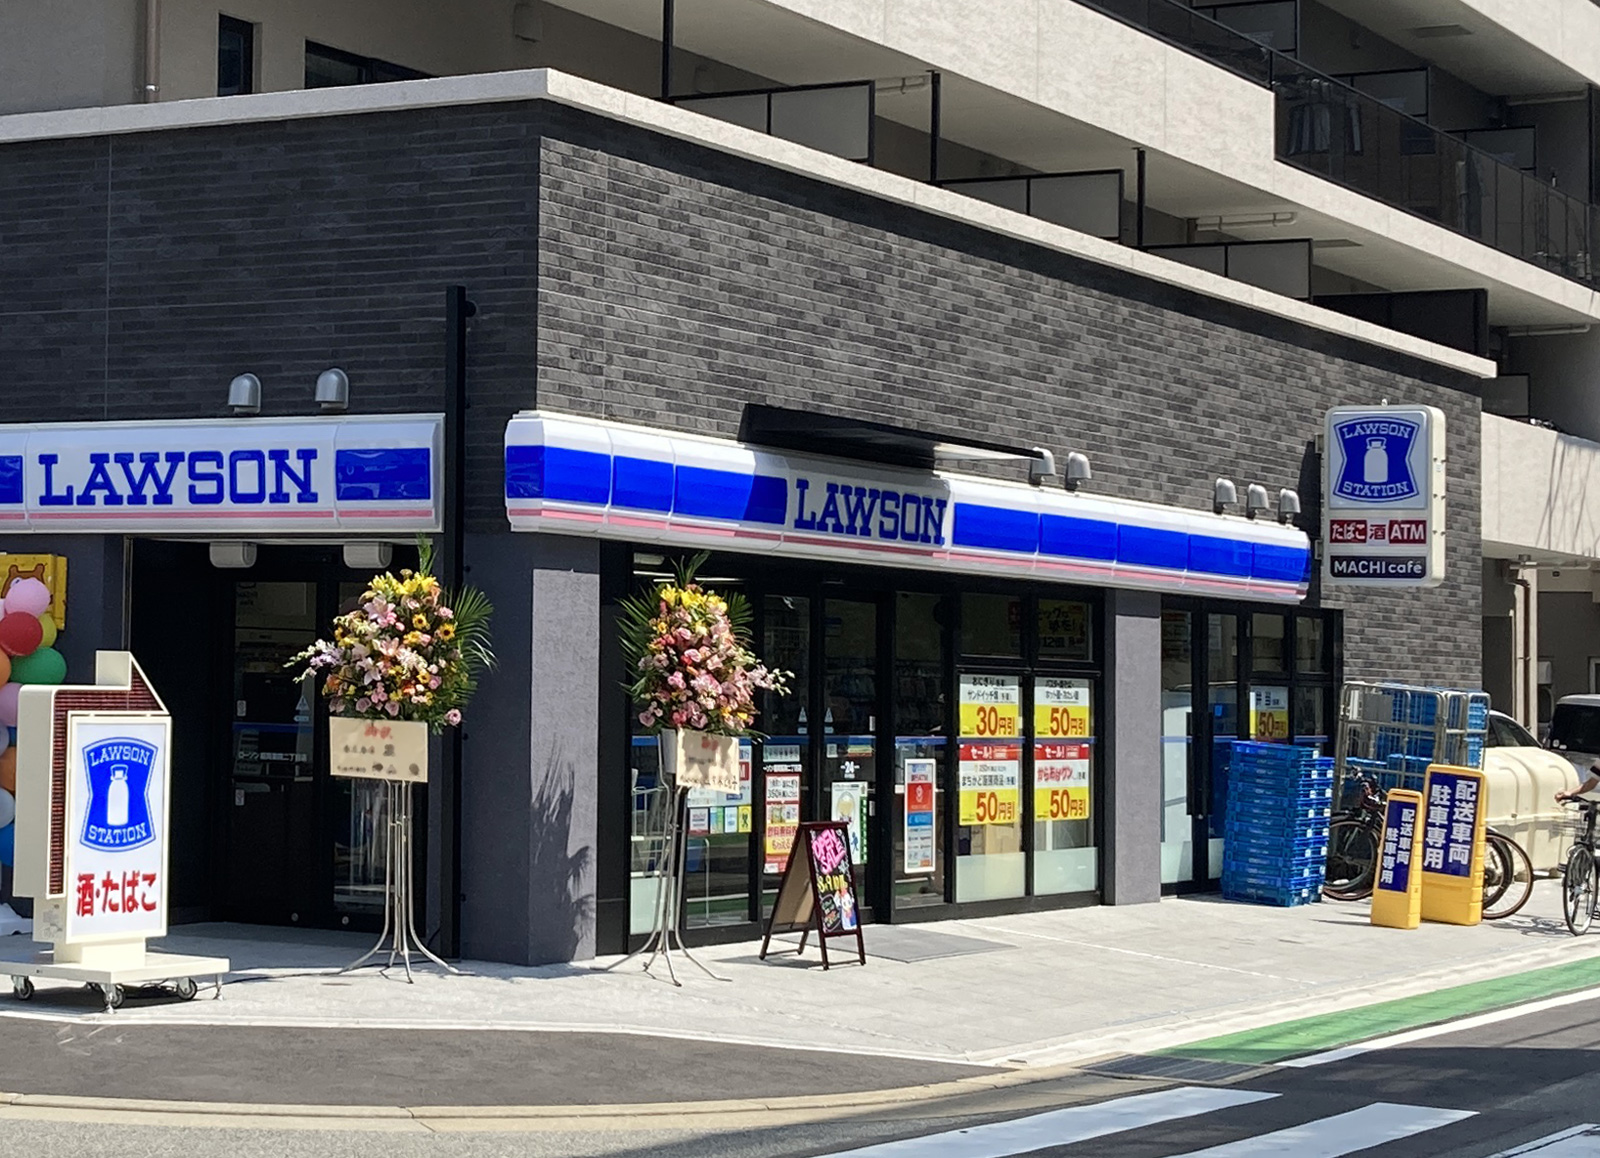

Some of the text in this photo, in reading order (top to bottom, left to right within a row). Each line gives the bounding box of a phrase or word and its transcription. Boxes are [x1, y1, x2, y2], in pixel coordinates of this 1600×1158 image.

[1342, 423, 1411, 439] LAWSON
[38, 448, 318, 506] LAWSON
[1342, 481, 1410, 496] STATION
[794, 478, 947, 546] LAWSON
[1331, 522, 1425, 541] たばこ 酒 ATM
[1333, 560, 1386, 574] MACHI
[89, 745, 151, 767] LAWSON
[87, 822, 148, 844] STATION
[1396, 808, 1416, 866] 配送車両
[1423, 784, 1452, 870] 駐車専用
[1448, 779, 1478, 866] 配送車両
[811, 828, 838, 860] OPEN
[820, 841, 847, 875] SALE
[1380, 827, 1399, 885] 駐車専用
